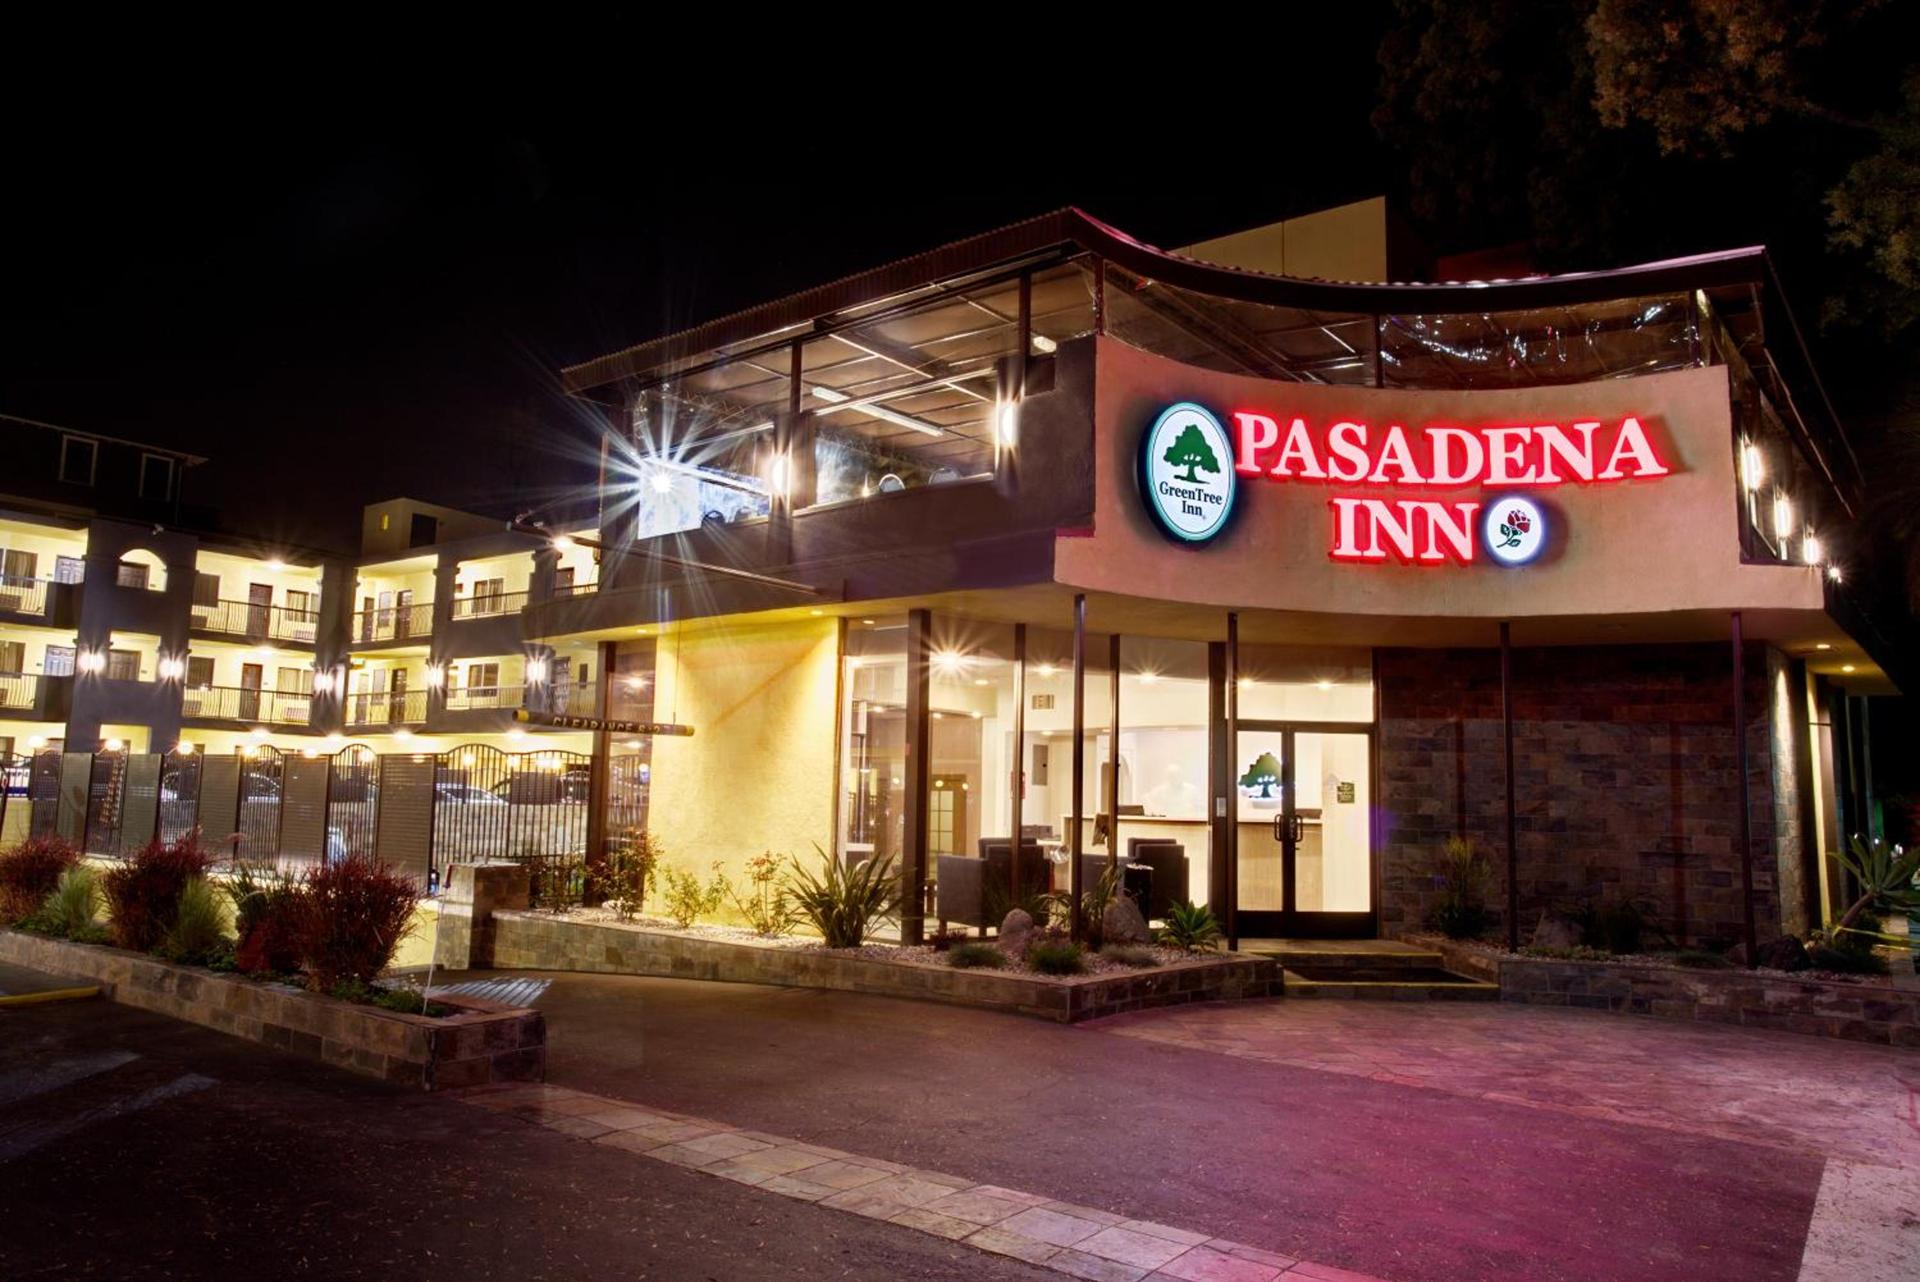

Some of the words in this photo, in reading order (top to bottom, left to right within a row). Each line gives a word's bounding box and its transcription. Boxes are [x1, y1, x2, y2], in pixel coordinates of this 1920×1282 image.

[1233, 411, 1669, 485] PASADENA
[1160, 480, 1223, 505] GreenTree
[1181, 499, 1203, 517] Inn
[1332, 497, 1480, 560] INN
